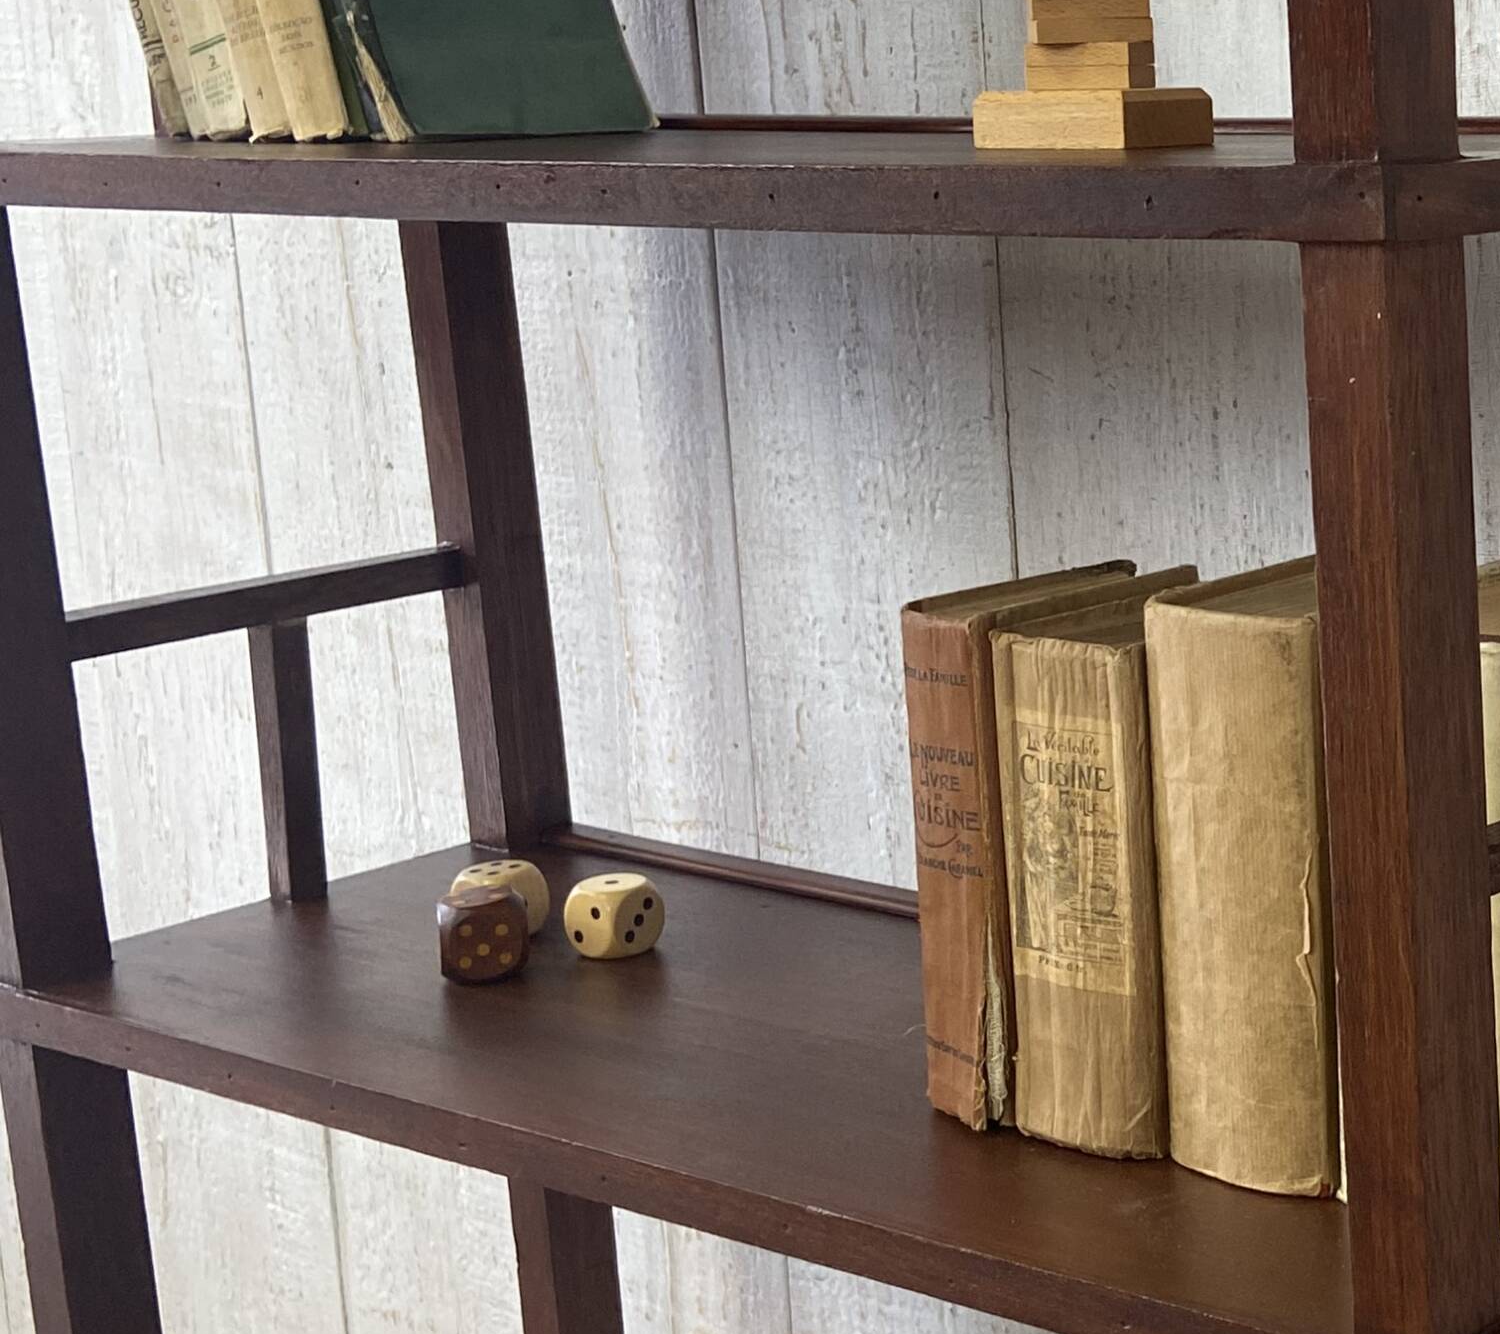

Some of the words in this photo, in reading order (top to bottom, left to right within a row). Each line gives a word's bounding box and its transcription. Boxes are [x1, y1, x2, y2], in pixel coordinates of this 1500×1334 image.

[920, 744, 975, 768] NOUVEAU
[920, 768, 962, 792] LIVRE
[1020, 754, 1115, 793] CUISINE
